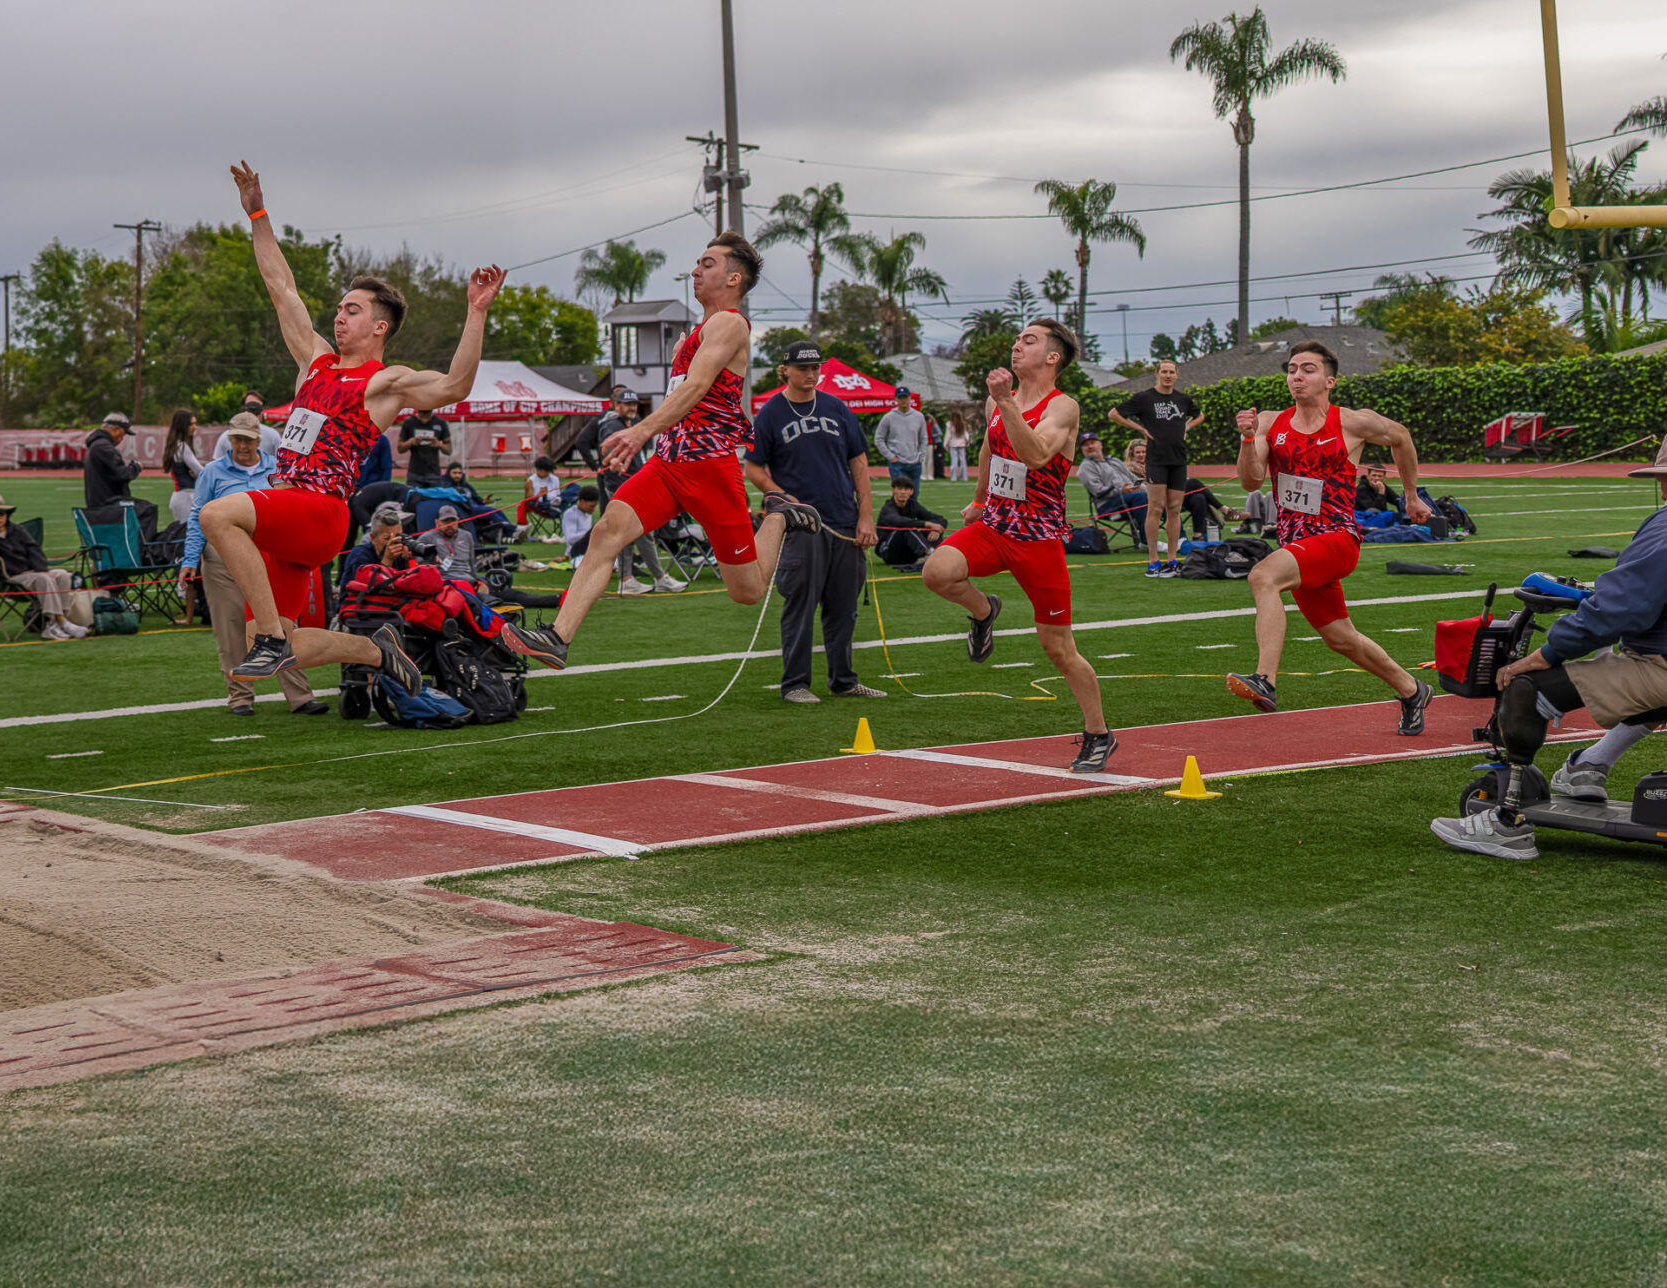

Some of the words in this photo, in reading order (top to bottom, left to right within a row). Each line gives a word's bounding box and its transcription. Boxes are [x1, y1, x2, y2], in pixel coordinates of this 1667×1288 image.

[470, 401, 501, 413] HOME
[503, 401, 517, 412] OF
[540, 401, 603, 412] CHAMPIONS
[849, 400, 863, 408] DEI
[864, 399, 884, 407] HIGH
[284, 424, 308, 443] 371
[782, 416, 840, 444] OCC
[993, 473, 1014, 491] 371
[1285, 489, 1309, 506] 371
